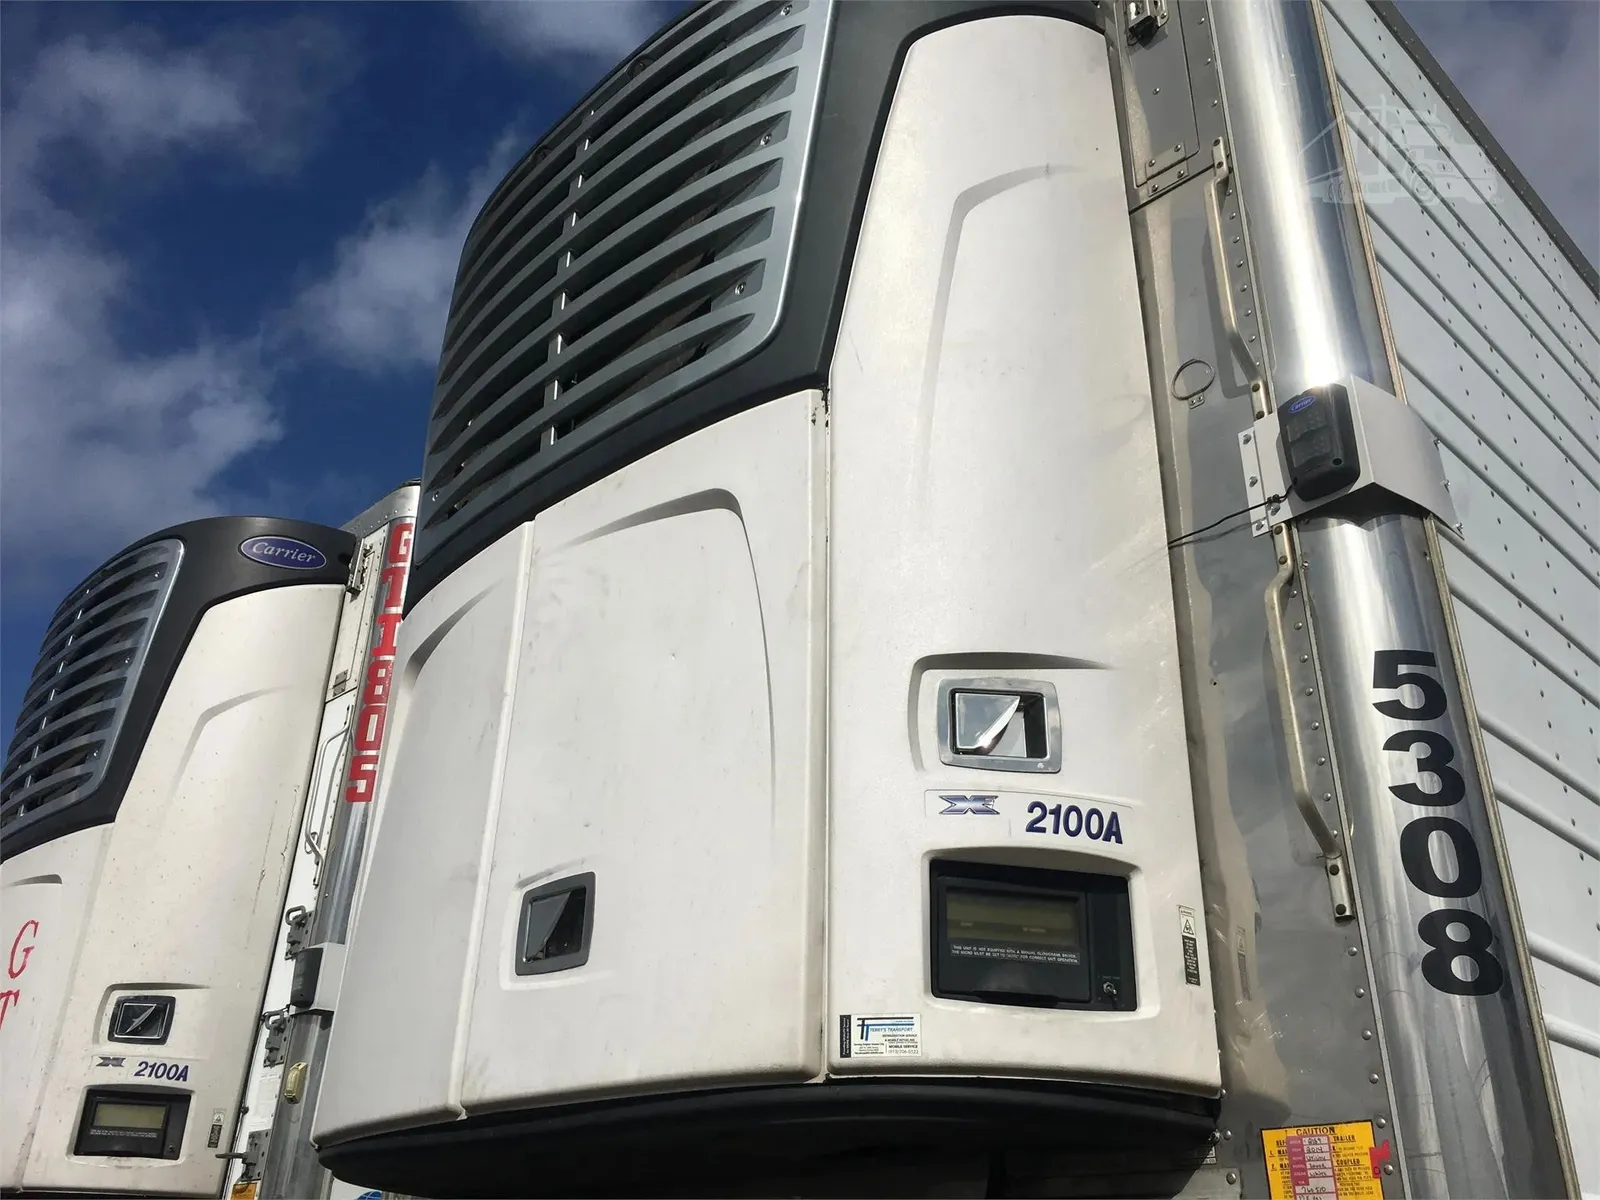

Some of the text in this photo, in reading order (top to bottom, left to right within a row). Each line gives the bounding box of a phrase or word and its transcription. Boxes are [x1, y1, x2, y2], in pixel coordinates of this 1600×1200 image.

[252, 541, 316, 563] Carrier
[1025, 800, 1123, 845] 2100A
[1372, 650, 1504, 997] 5308
[133, 1060, 190, 1083] 2100A
[1296, 1126, 1337, 1136] CAUTION
[1336, 1158, 1361, 1166] COUPLED
